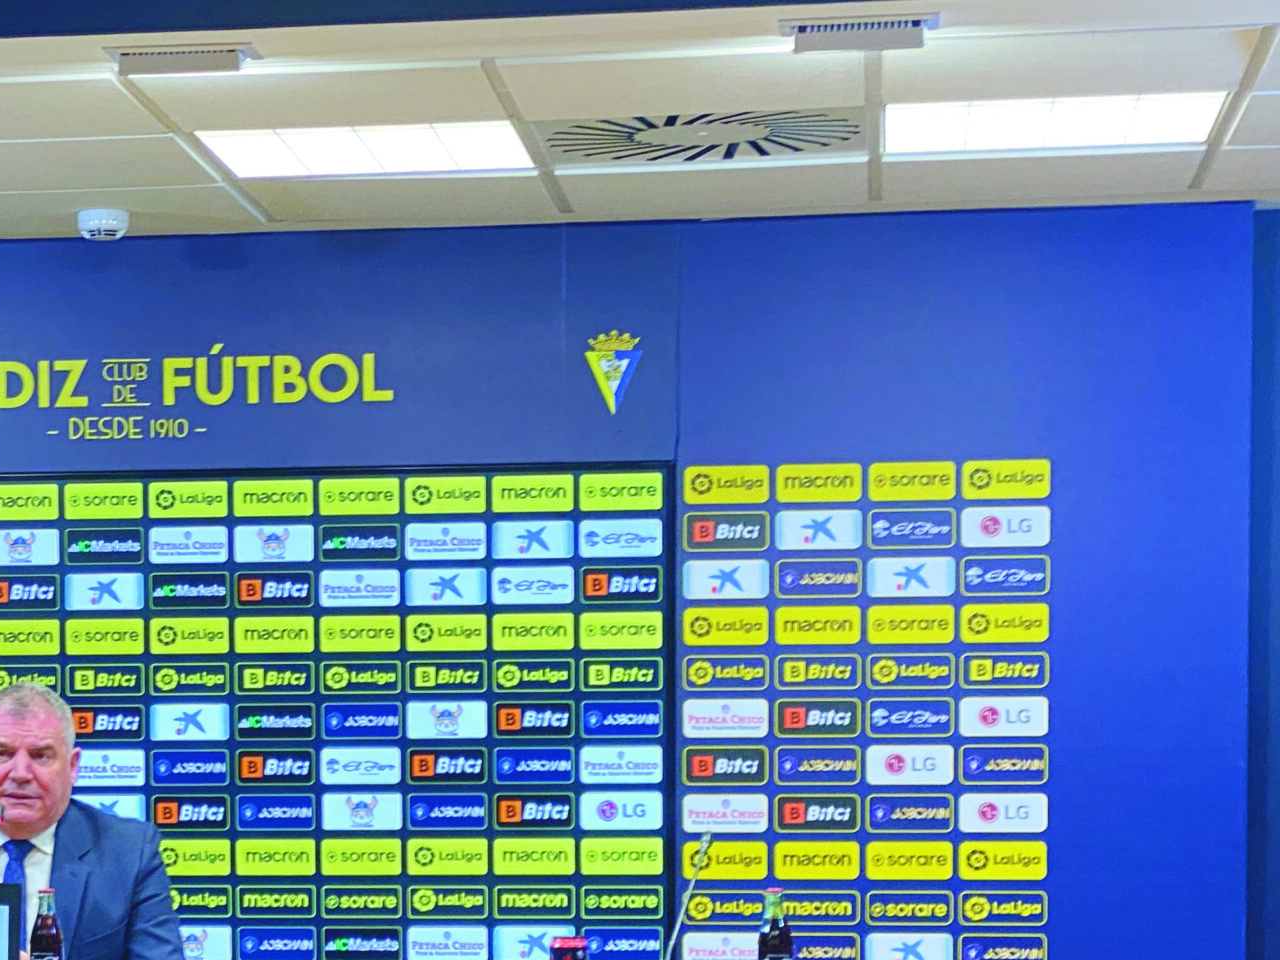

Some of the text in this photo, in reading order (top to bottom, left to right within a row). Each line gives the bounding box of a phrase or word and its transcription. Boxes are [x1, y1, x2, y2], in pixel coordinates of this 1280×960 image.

[102, 362, 148, 381] CLUB
[162, 343, 394, 406] FÚTBOL
[112, 384, 136, 404] DE
[68, 416, 189, 440] DESDE 1910
[715, 476, 763, 491] LaLiga
[784, 475, 853, 489] macron
[890, 473, 950, 487] sorare
[995, 471, 1045, 486] LaLiga
[178, 491, 222, 505] LaLiga
[241, 490, 306, 503] macron
[339, 488, 394, 501] sorare
[435, 487, 481, 501] LaLiga
[499, 486, 566, 499] macron
[600, 484, 657, 497] sorare
[84, 493, 138, 506] sorare
[715, 523, 760, 540] Bitci
[1007, 517, 1033, 534] LG
[9, 583, 54, 599] Bitci
[262, 580, 308, 596] Bitci
[609, 575, 657, 592] Bitci
[600, 622, 657, 635] sorare
[715, 618, 762, 632] LaLiga
[783, 617, 852, 631] macron
[889, 615, 949, 629] sorare
[994, 614, 1043, 629] LaLiga
[85, 628, 139, 641] sorare
[180, 627, 224, 641] LaLiga
[242, 627, 306, 640] macron
[340, 625, 395, 638] sorare
[436, 624, 481, 638] LaLiga
[500, 623, 566, 637] macron
[264, 670, 306, 685] Bitci
[349, 669, 396, 684] LaLiga
[436, 668, 479, 683] Bitci
[522, 668, 569, 683] LaLiga
[610, 666, 655, 681] Bitci
[993, 662, 1040, 678] Bitci
[95, 672, 137, 686] Bitci
[179, 671, 224, 686] LaLiga
[94, 713, 139, 730] Bitci
[521, 710, 569, 727] Bitci
[806, 709, 852, 726] Bitci
[1006, 707, 1032, 723] LG
[263, 757, 309, 774] Bitci
[435, 756, 482, 773] Bitci
[714, 757, 759, 773] Bitci
[912, 756, 937, 772] LG
[179, 803, 225, 820] Bitci
[522, 802, 569, 819] Bitci
[623, 802, 647, 818] LG
[806, 805, 852, 821] Bitci
[1005, 804, 1031, 820] LG
[182, 849, 226, 863] LaLiga
[243, 849, 307, 862] macron
[341, 849, 396, 862] sorare
[437, 848, 482, 863] LaLiga
[501, 849, 567, 862] macron
[601, 848, 657, 861] sorare
[714, 852, 762, 866] LaLiga
[782, 852, 851, 866] macron
[887, 852, 947, 866] sorare
[992, 852, 1041, 867] LaLiga
[181, 894, 227, 909] LaLiga
[242, 895, 308, 908] macron
[341, 894, 396, 907] sorare
[436, 894, 483, 910] LaLiga
[500, 895, 568, 908] macron
[601, 894, 657, 907] sorare
[780, 900, 852, 914] macron
[990, 900, 1041, 916] LaLiga
[887, 901, 947, 916] sorare
